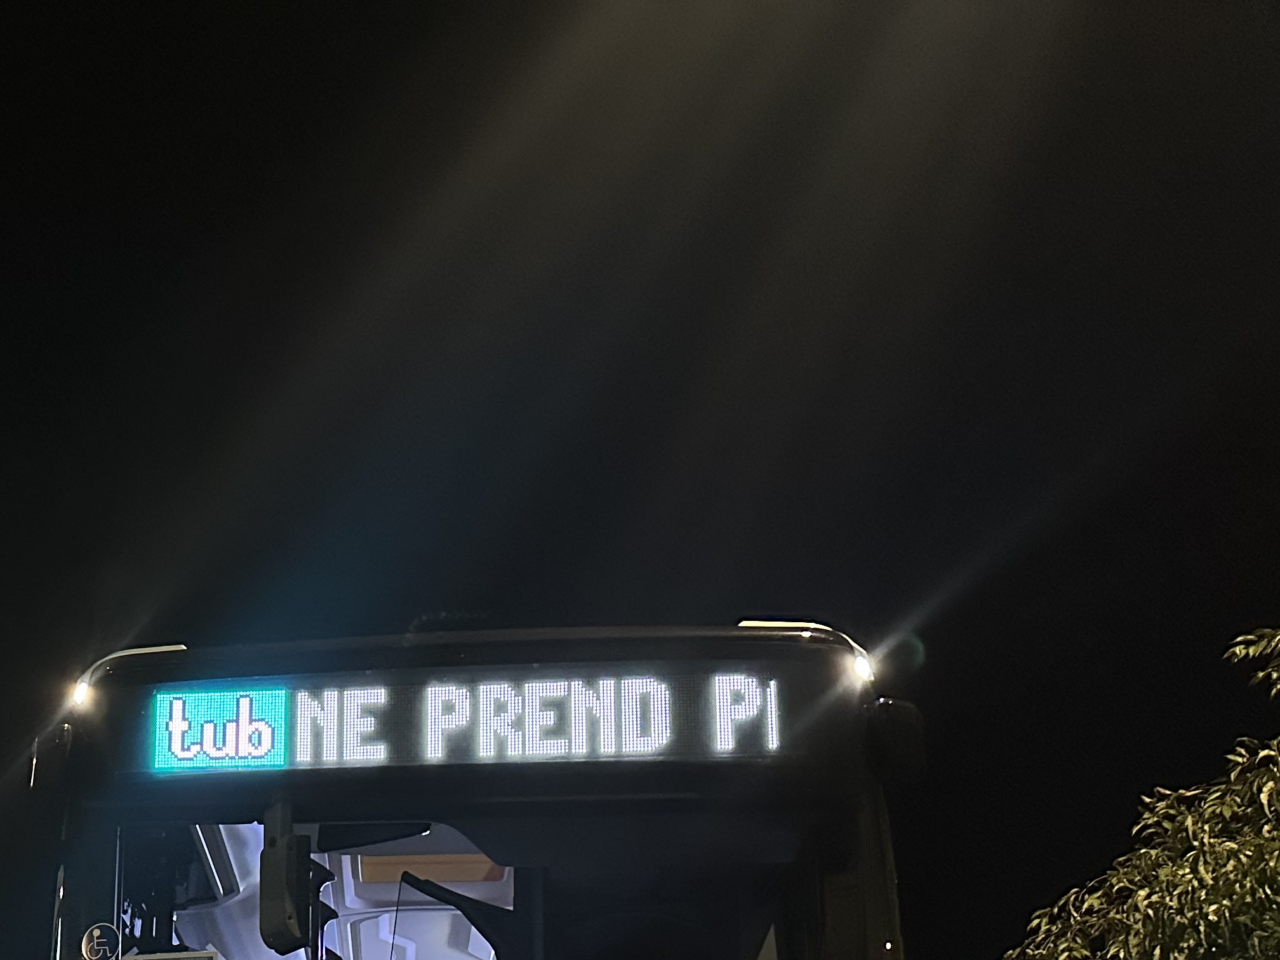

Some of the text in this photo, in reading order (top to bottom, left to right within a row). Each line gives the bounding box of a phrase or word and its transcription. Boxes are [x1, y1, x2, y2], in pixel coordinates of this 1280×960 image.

[167, 695, 275, 758] tub
[295, 674, 779, 761] NE PREND P
